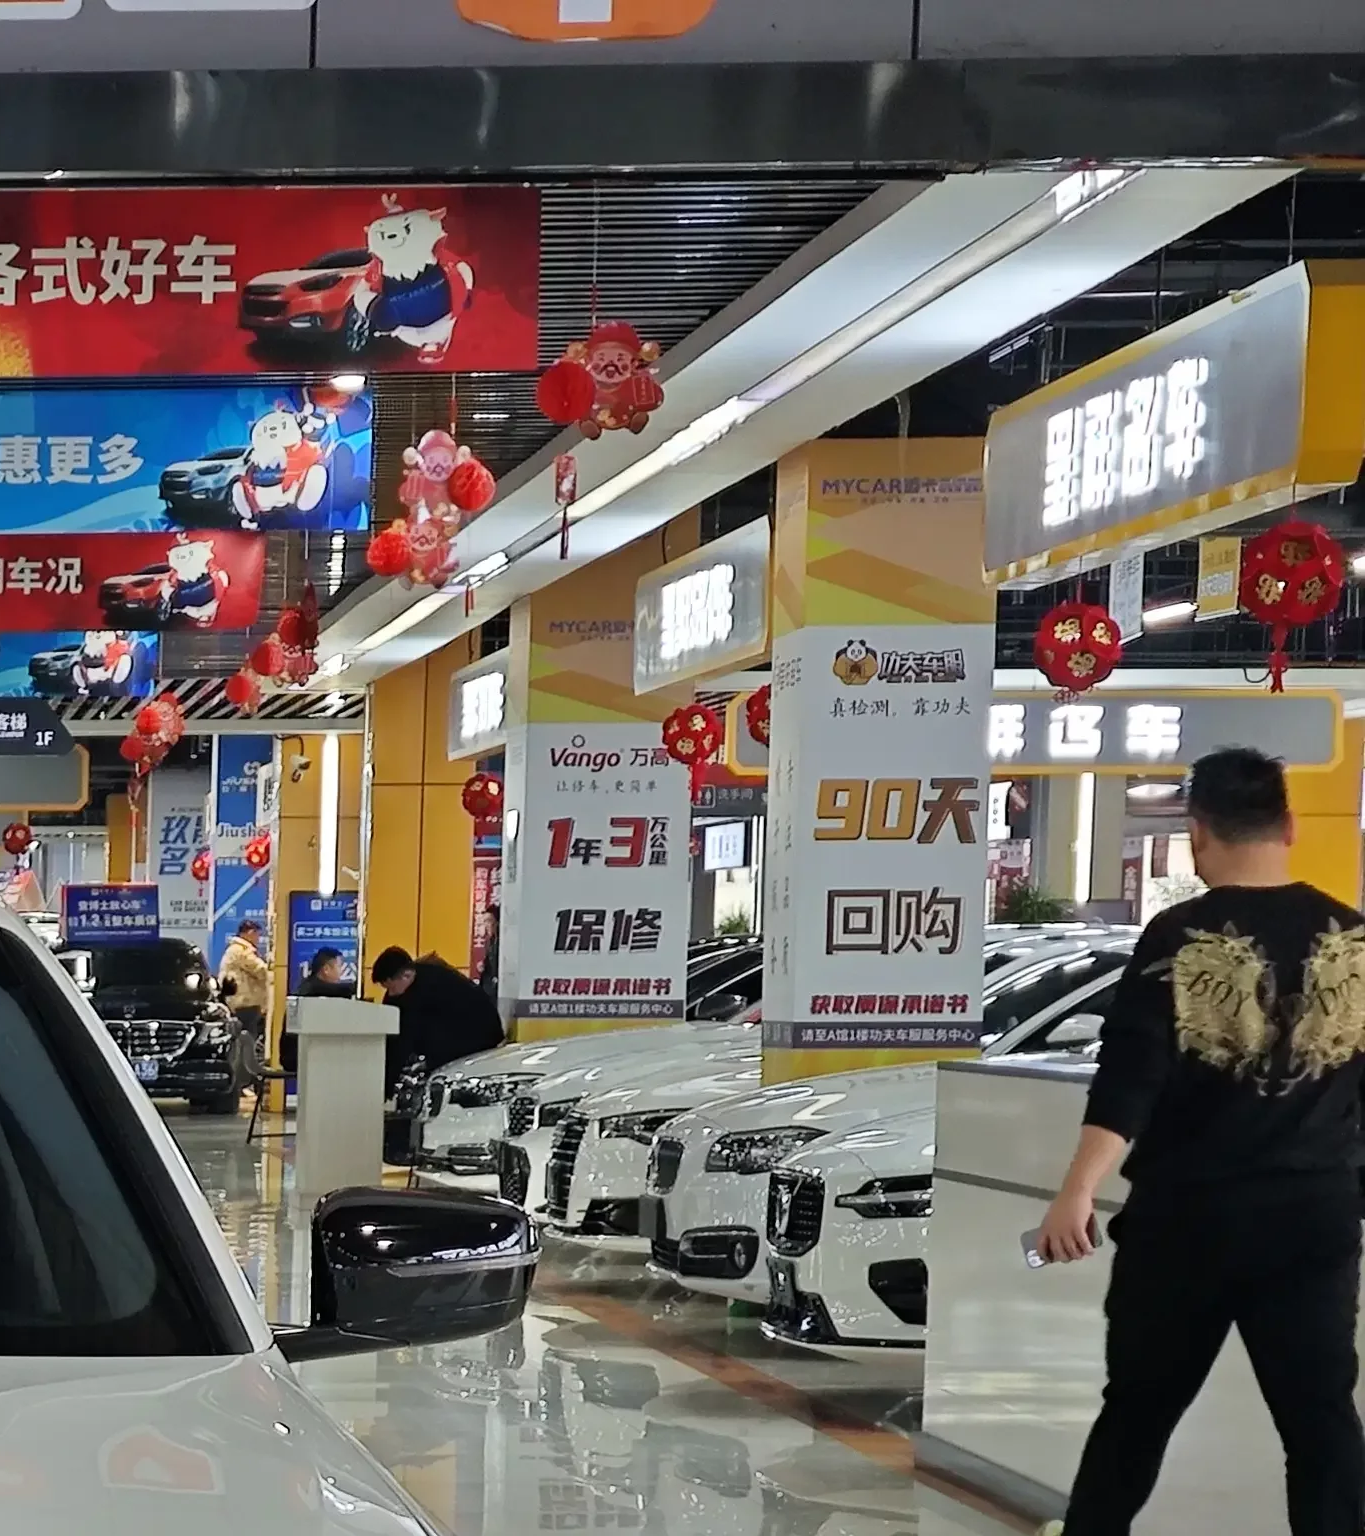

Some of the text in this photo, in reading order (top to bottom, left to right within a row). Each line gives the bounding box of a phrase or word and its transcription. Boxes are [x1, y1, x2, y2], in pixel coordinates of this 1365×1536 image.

[878, 650, 966, 684] 功夫车服
[34, 731, 54, 746] 1F
[549, 747, 621, 773] Vango
[813, 777, 981, 844] 90天
[553, 908, 662, 955] 保修
[825, 886, 966, 955] 回购
[800, 1028, 976, 1043] 请至A馆1楼功夫车服服务中心
